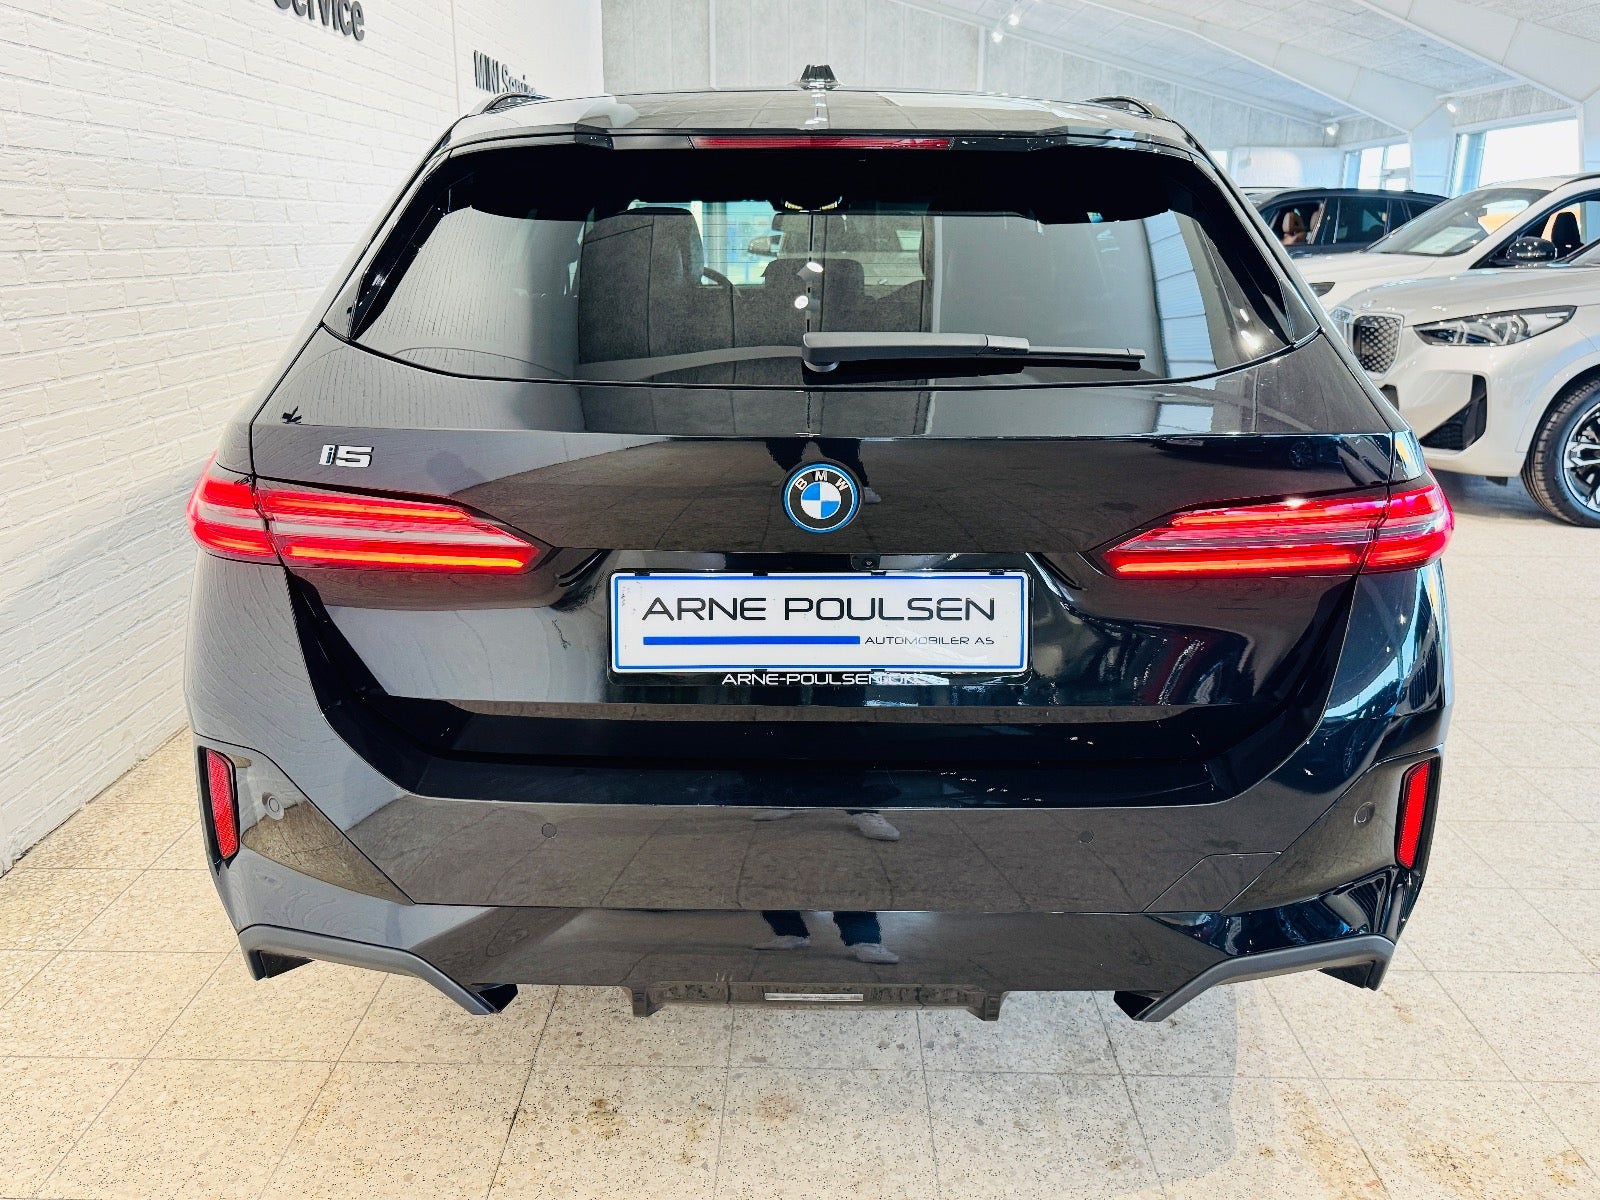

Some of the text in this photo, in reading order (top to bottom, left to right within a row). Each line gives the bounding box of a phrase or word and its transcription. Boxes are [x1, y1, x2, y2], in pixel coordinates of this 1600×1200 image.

[273, 0, 365, 41] vice
[473, 49, 500, 94] MINI
[319, 444, 374, 468] i5
[794, 469, 849, 491] BMW
[641, 597, 995, 621] ARNE POULSEN
[864, 636, 995, 645] AUTOMOBILER AS
